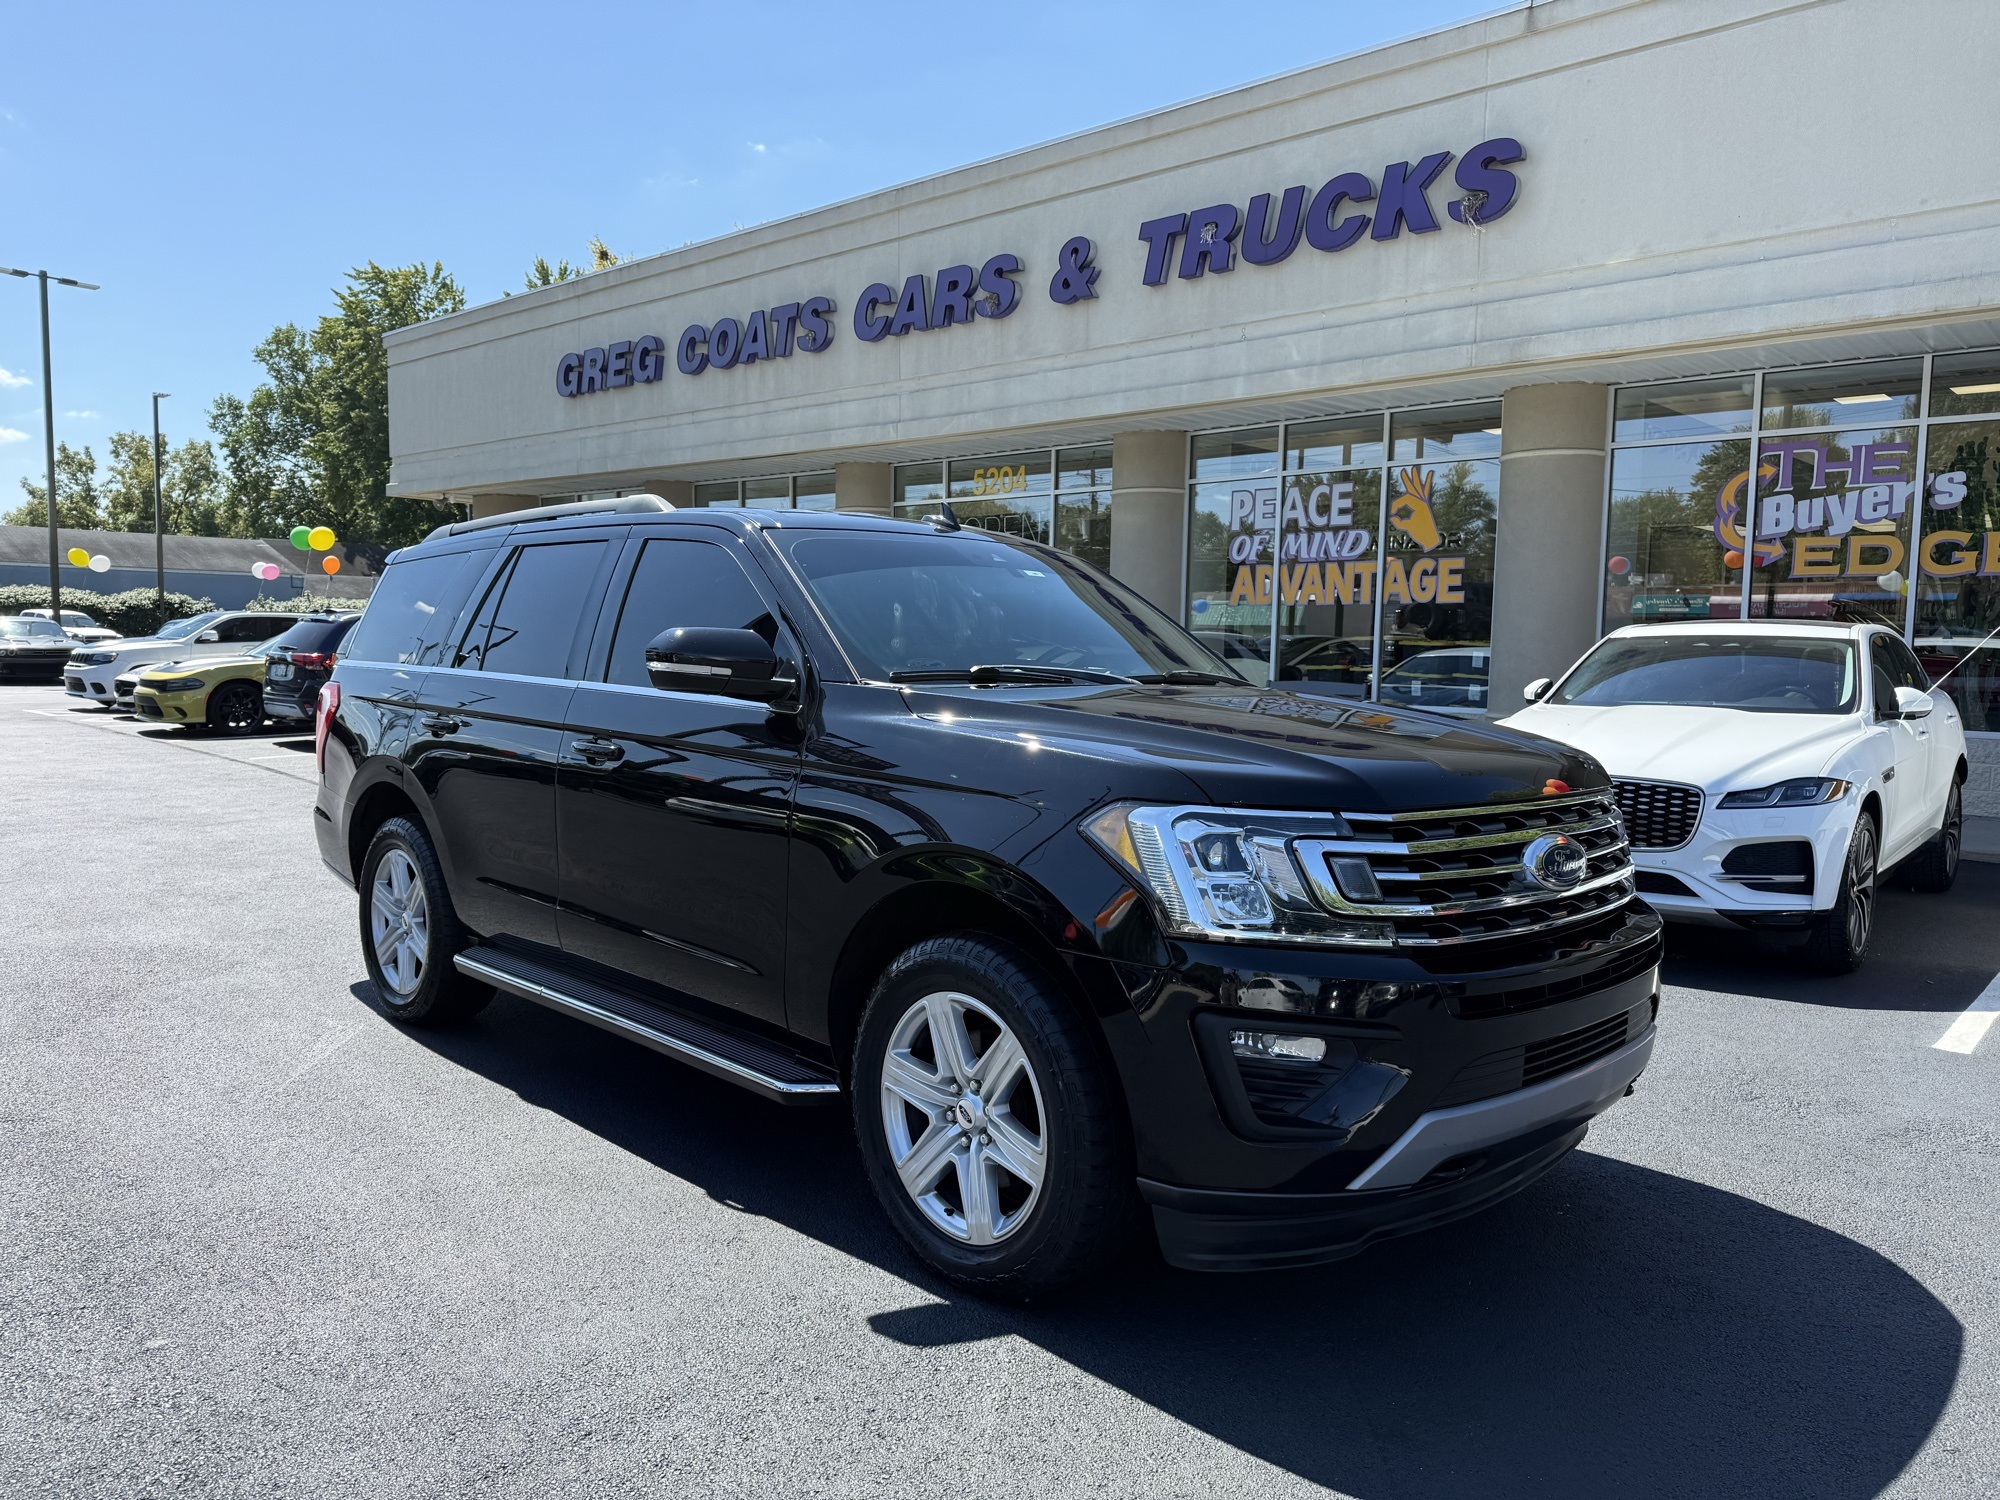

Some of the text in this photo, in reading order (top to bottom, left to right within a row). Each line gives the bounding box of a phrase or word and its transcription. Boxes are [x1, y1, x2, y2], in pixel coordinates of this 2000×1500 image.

[556, 137, 1528, 398] GREG COATS CARS & TRUCKS
[972, 464, 1028, 496] 5204
[1758, 440, 1909, 492] THE
[1230, 483, 1355, 533] PEACE
[1757, 470, 1968, 540] Buyer's
[1229, 533, 1270, 565] OF
[1281, 528, 1371, 564] MIND
[1228, 556, 1466, 607] ADVANTAGE
